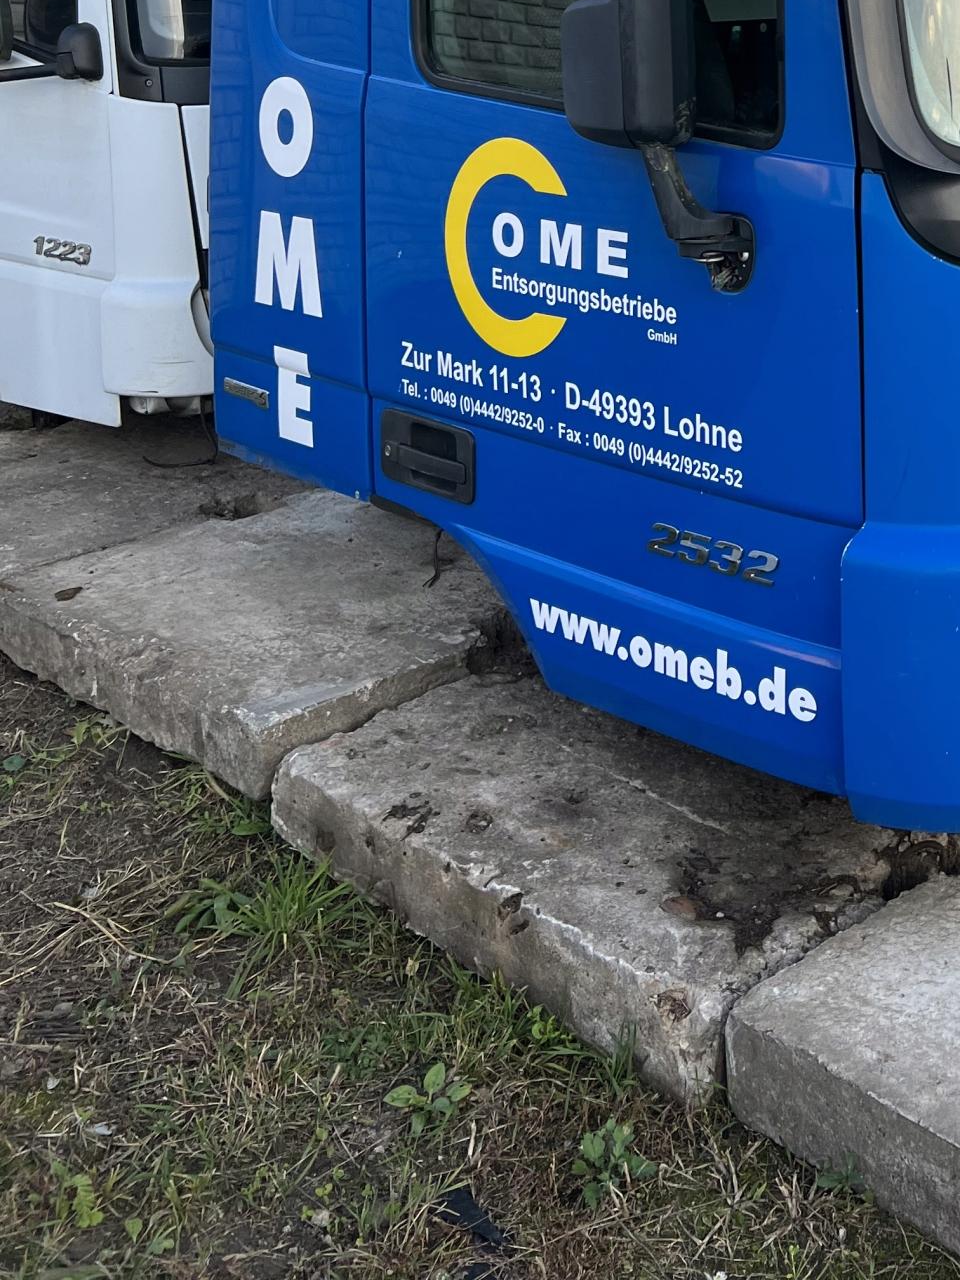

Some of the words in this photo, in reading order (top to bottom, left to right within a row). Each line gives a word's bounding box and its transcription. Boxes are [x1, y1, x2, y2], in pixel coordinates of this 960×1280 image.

[33, 235, 92, 266] 1223
[491, 211, 629, 279] OME
[491, 267, 678, 325] Entsorgungsbetriebe
[646, 328, 678, 345] GmbH
[401, 340, 432, 372] Zur
[437, 350, 484, 387] Mark
[489, 364, 542, 403] 11-13
[564, 381, 656, 431] D-49393
[663, 405, 743, 453] Lohne
[430, 386, 457, 409] 0049
[459, 394, 545, 434] (0)4442/9252-0
[593, 432, 625, 457] 0049
[628, 441, 744, 489] (0)4442/9252-52
[647, 522, 780, 588] 2532
[529, 597, 818, 723] www.omeb.de
